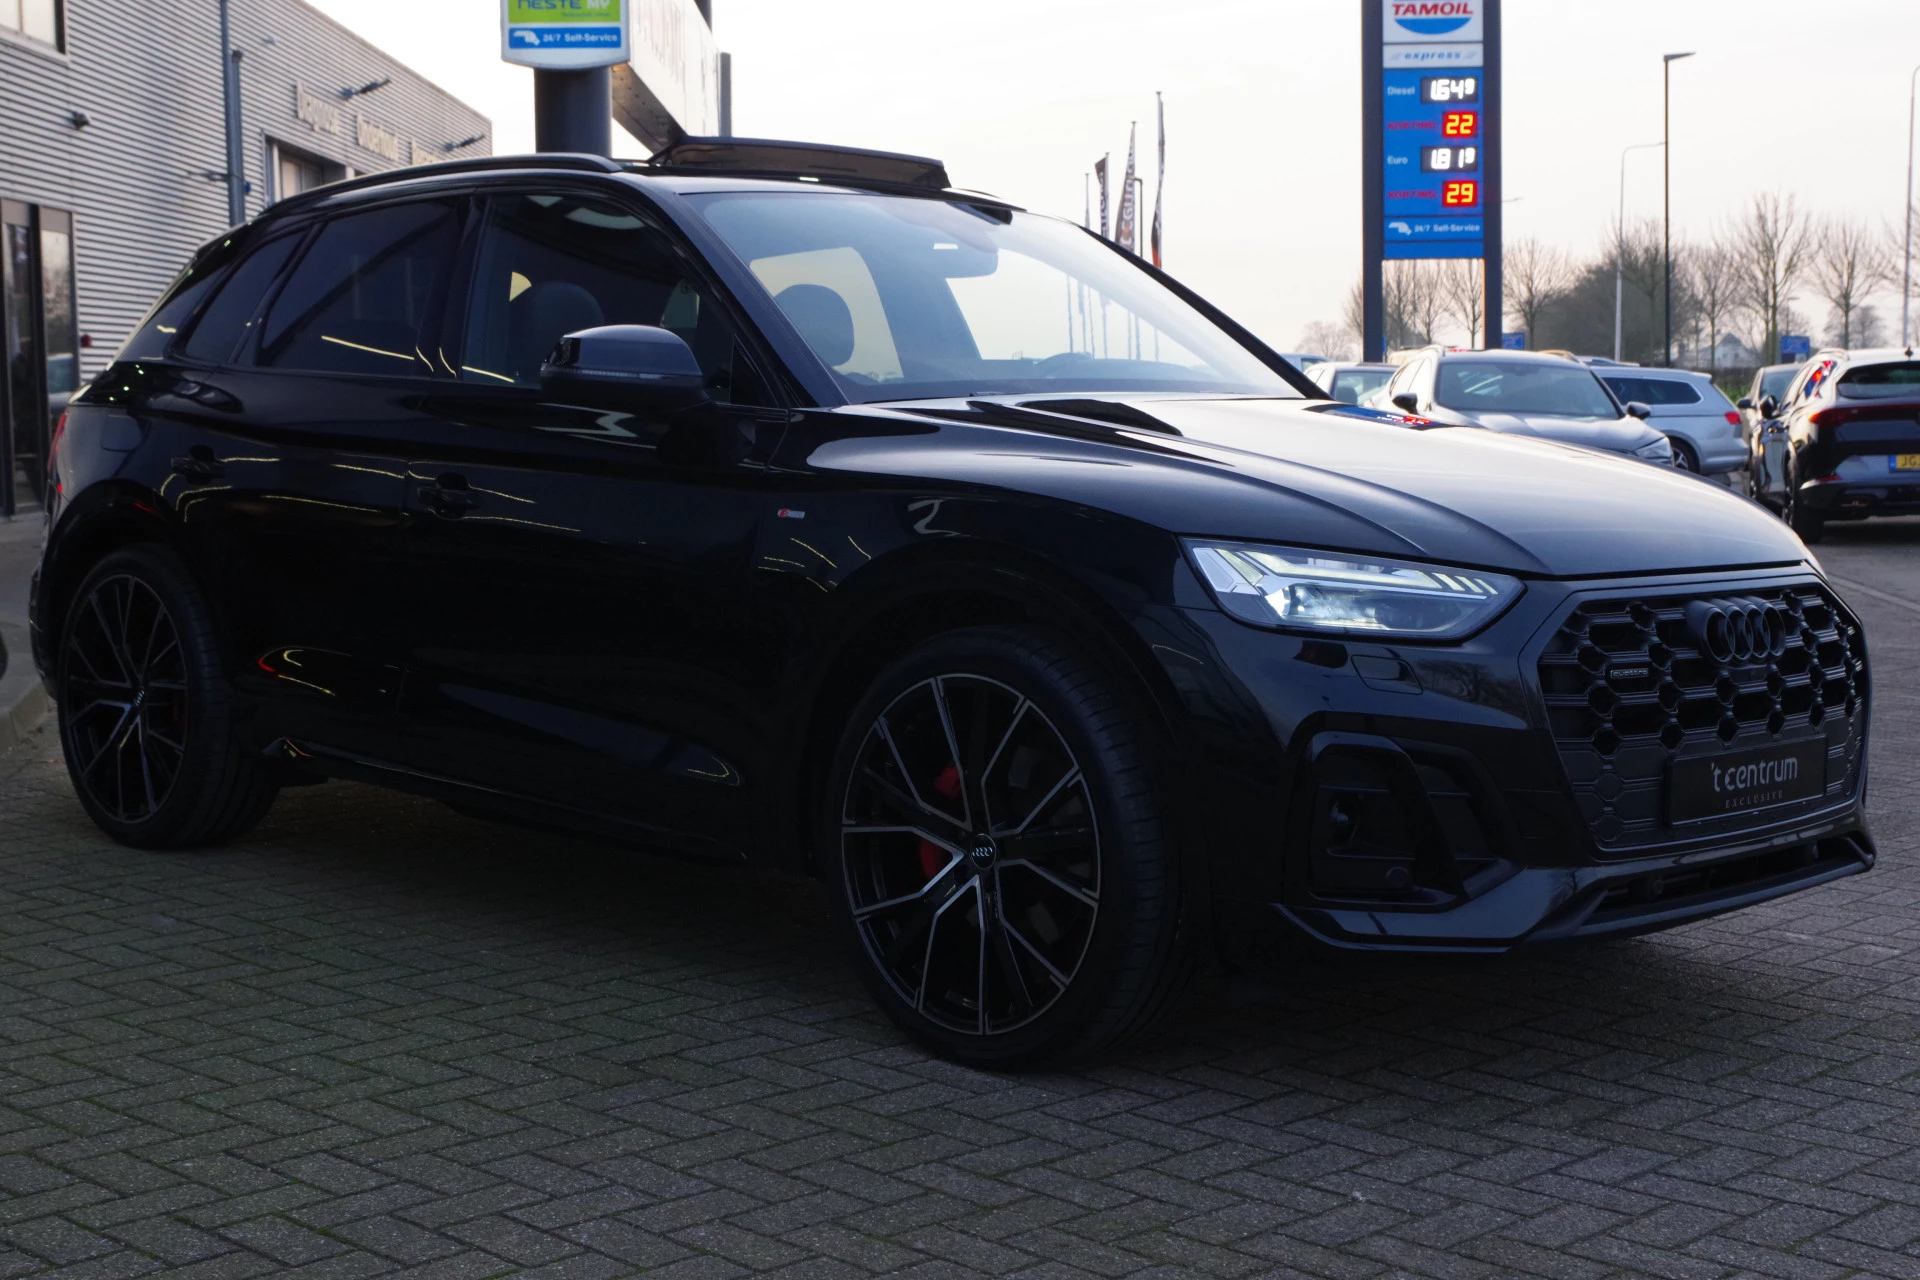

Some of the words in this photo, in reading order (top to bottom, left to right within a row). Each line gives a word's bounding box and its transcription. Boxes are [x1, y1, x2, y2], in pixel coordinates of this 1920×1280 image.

[1392, 2, 1474, 16] TAMOIL
[564, 33, 618, 43] Self-Service
[1404, 51, 1462, 61] express
[1387, 86, 1416, 96] Diesel
[1446, 114, 1474, 135] 22
[1387, 156, 1409, 165] Euro
[1446, 183, 1474, 204] 29
[1433, 224, 1481, 233] Self-Service
[1726, 790, 1783, 809] EXCLUSIVE
